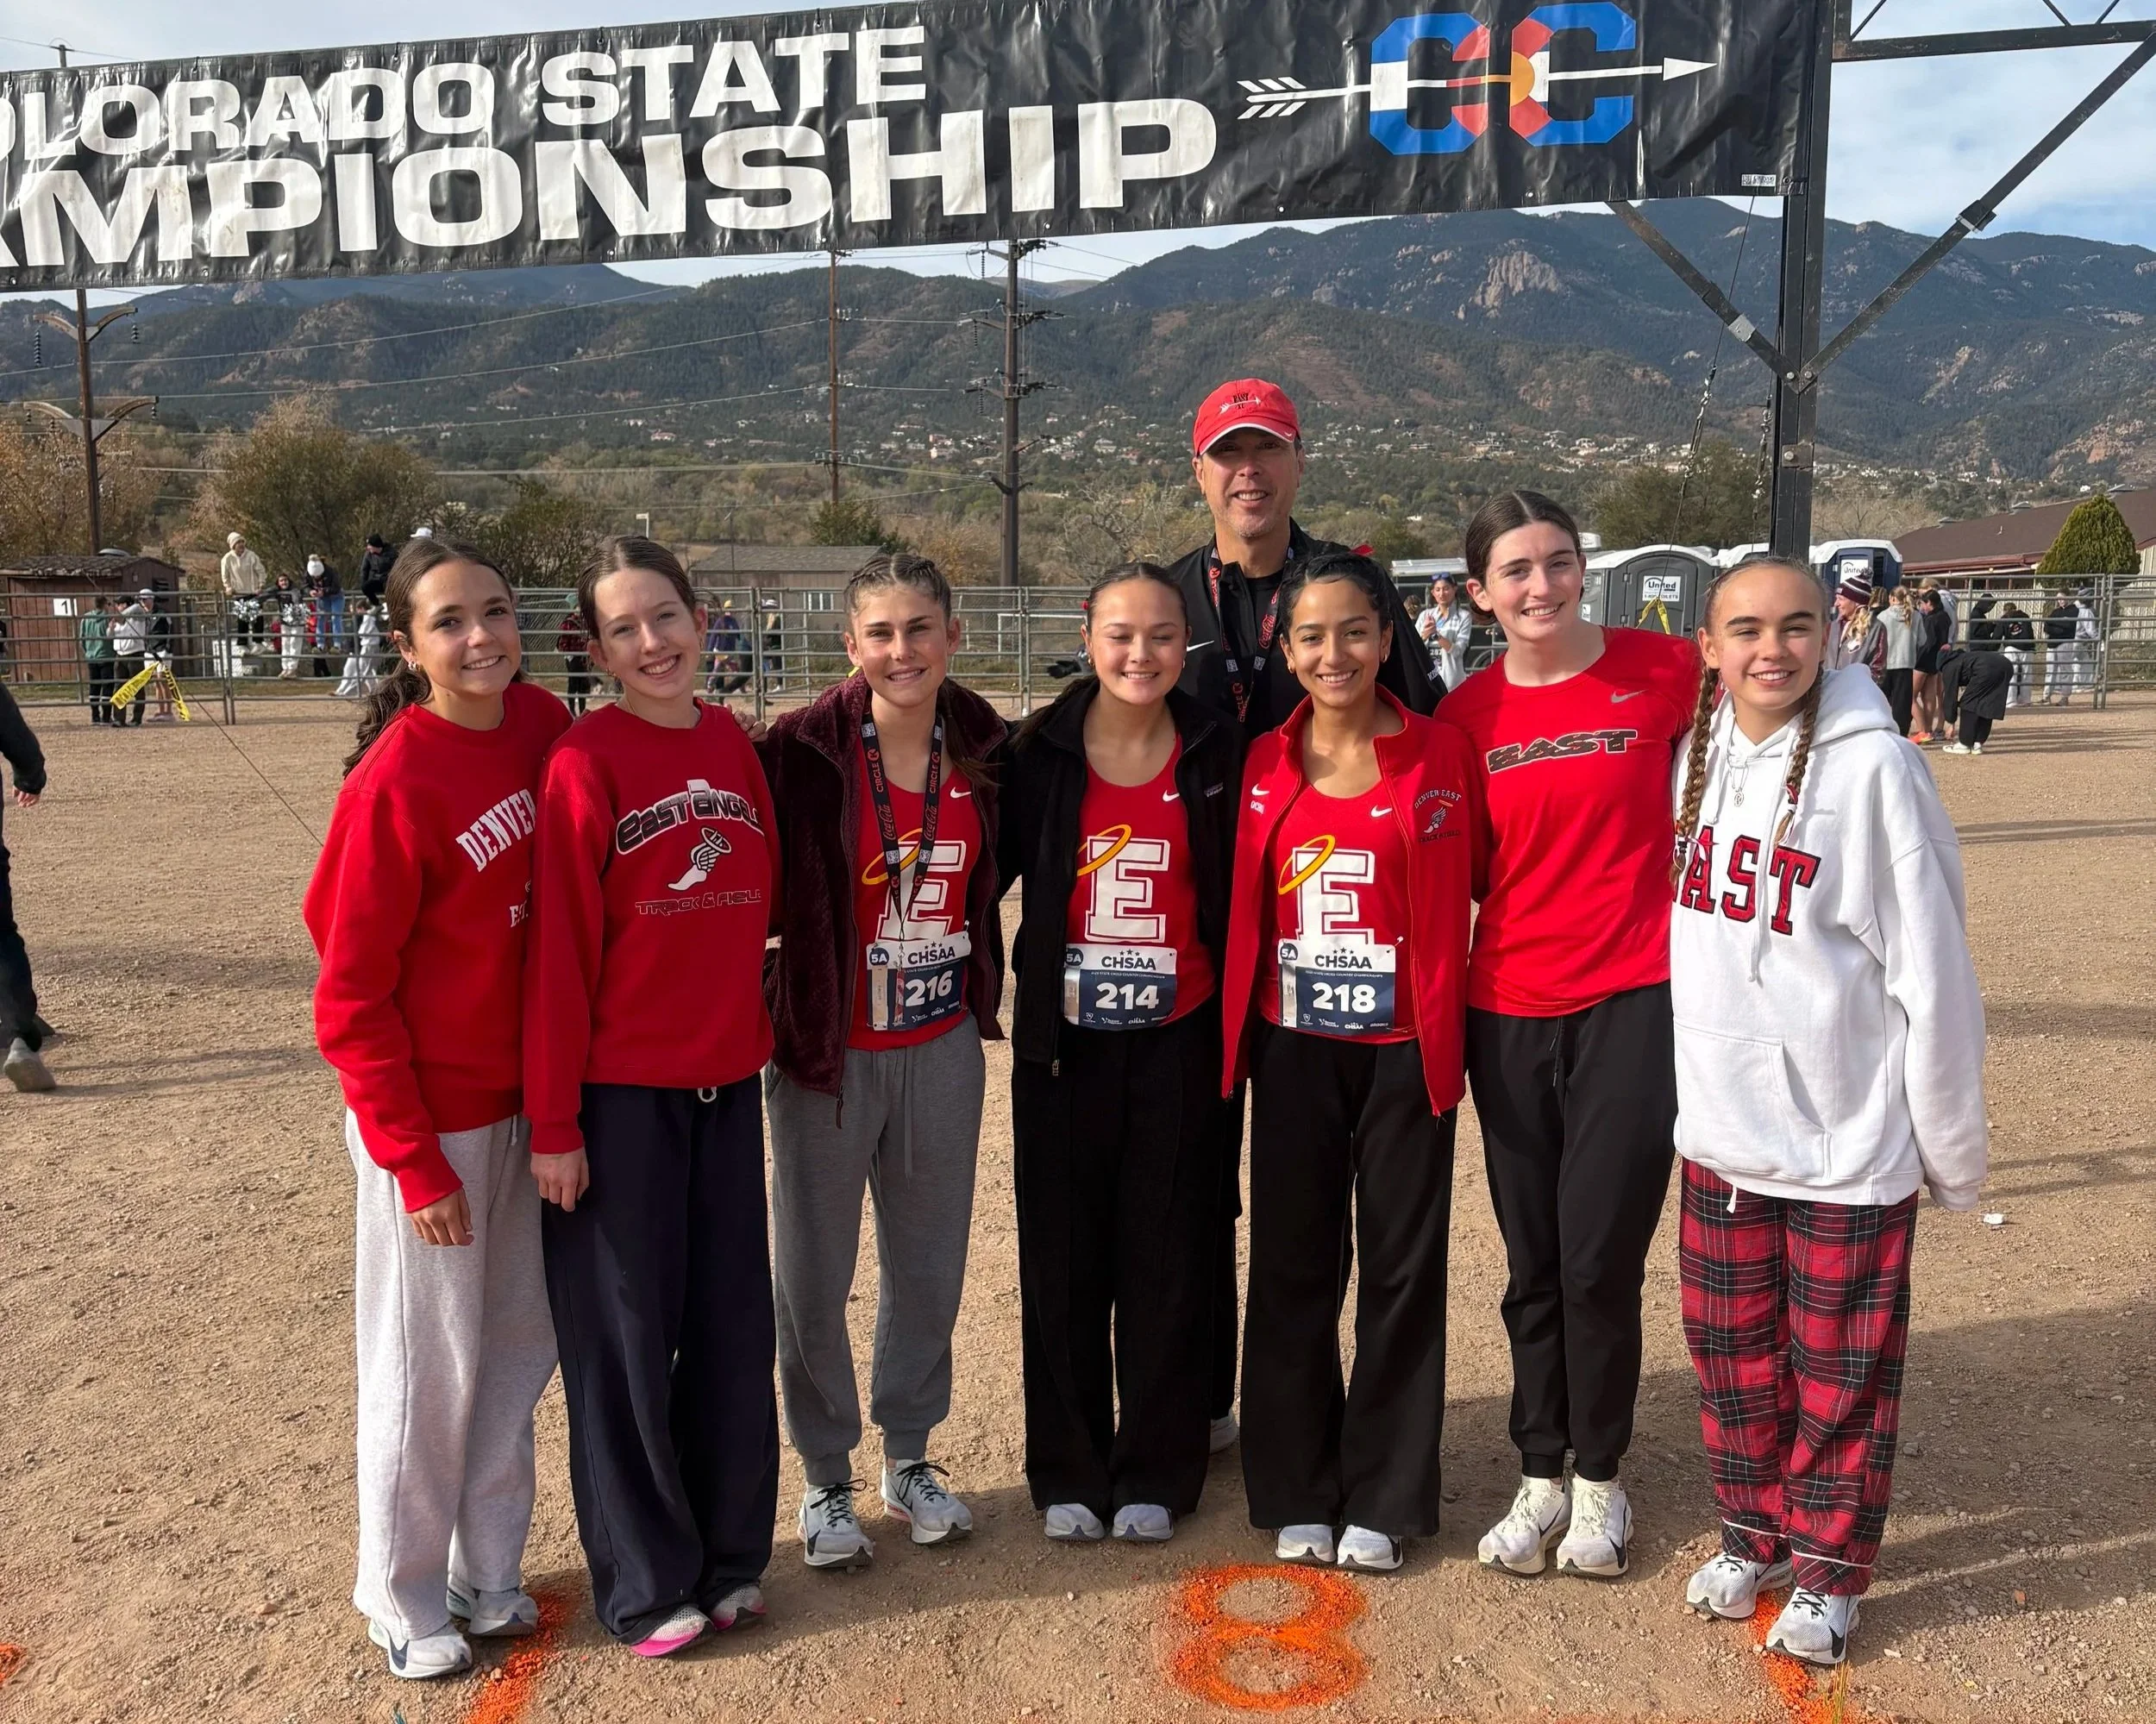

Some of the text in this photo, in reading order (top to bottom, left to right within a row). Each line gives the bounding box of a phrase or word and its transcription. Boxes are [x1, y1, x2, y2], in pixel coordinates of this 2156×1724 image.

[0, 25, 927, 162] LORADO STATE
[0, 97, 1218, 268] MPIONSHIP
[1648, 580, 1677, 589] Unted
[1486, 729, 1638, 774] EAST
[874, 762, 885, 793] CIRCLE
[1414, 789, 1462, 809] DENVER EAST
[1084, 836, 1171, 943] E
[1673, 824, 1821, 937] AST
[702, 892, 716, 908] &
[1291, 847, 1376, 945] E
[871, 953, 887, 963] 5A
[907, 945, 956, 966] CHSAA
[1066, 953, 1081, 963] 5A
[1100, 956, 1156, 971] CHSAA
[1281, 948, 1297, 958] 5A
[1314, 954, 1373, 969] CHSAA
[905, 969, 954, 1007] 216
[1095, 981, 1160, 1010] 214
[1312, 981, 1376, 1013] 218
[1171, 1563, 1371, 1712] 8
